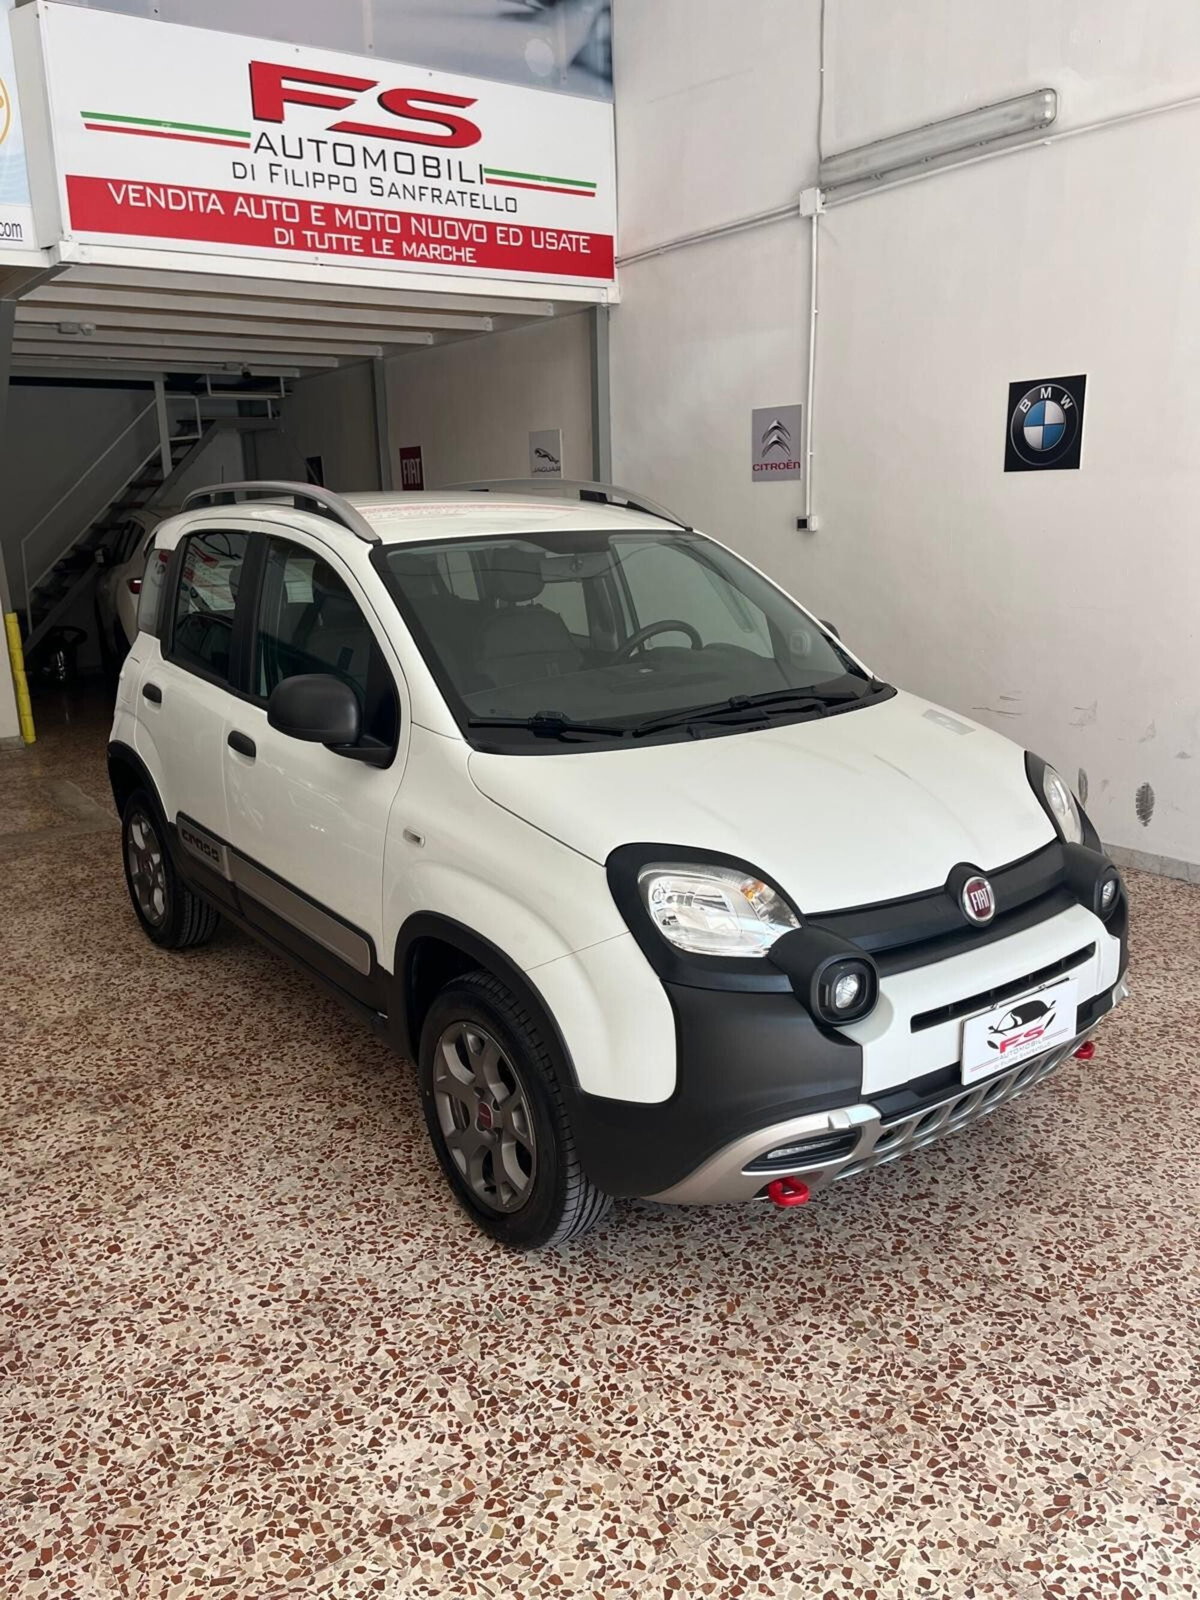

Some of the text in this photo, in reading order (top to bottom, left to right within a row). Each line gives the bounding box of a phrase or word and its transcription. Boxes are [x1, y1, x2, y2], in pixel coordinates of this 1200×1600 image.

[248, 60, 482, 149] FS
[253, 132, 484, 185] AUTOMOBILI
[232, 161, 518, 213] DI FILIPPO SANFRATELLO
[107, 182, 591, 253] VENDITA AUTO E MOTO NUOVO ED USATE
[274, 227, 477, 263] DI TUTTE LE MARCHE
[1019, 386, 1073, 413] BMW
[402, 458, 421, 485] FIAT
[533, 465, 561, 473] JAGUAR
[970, 887, 990, 912] FIAT
[999, 1024, 1045, 1054] FS
